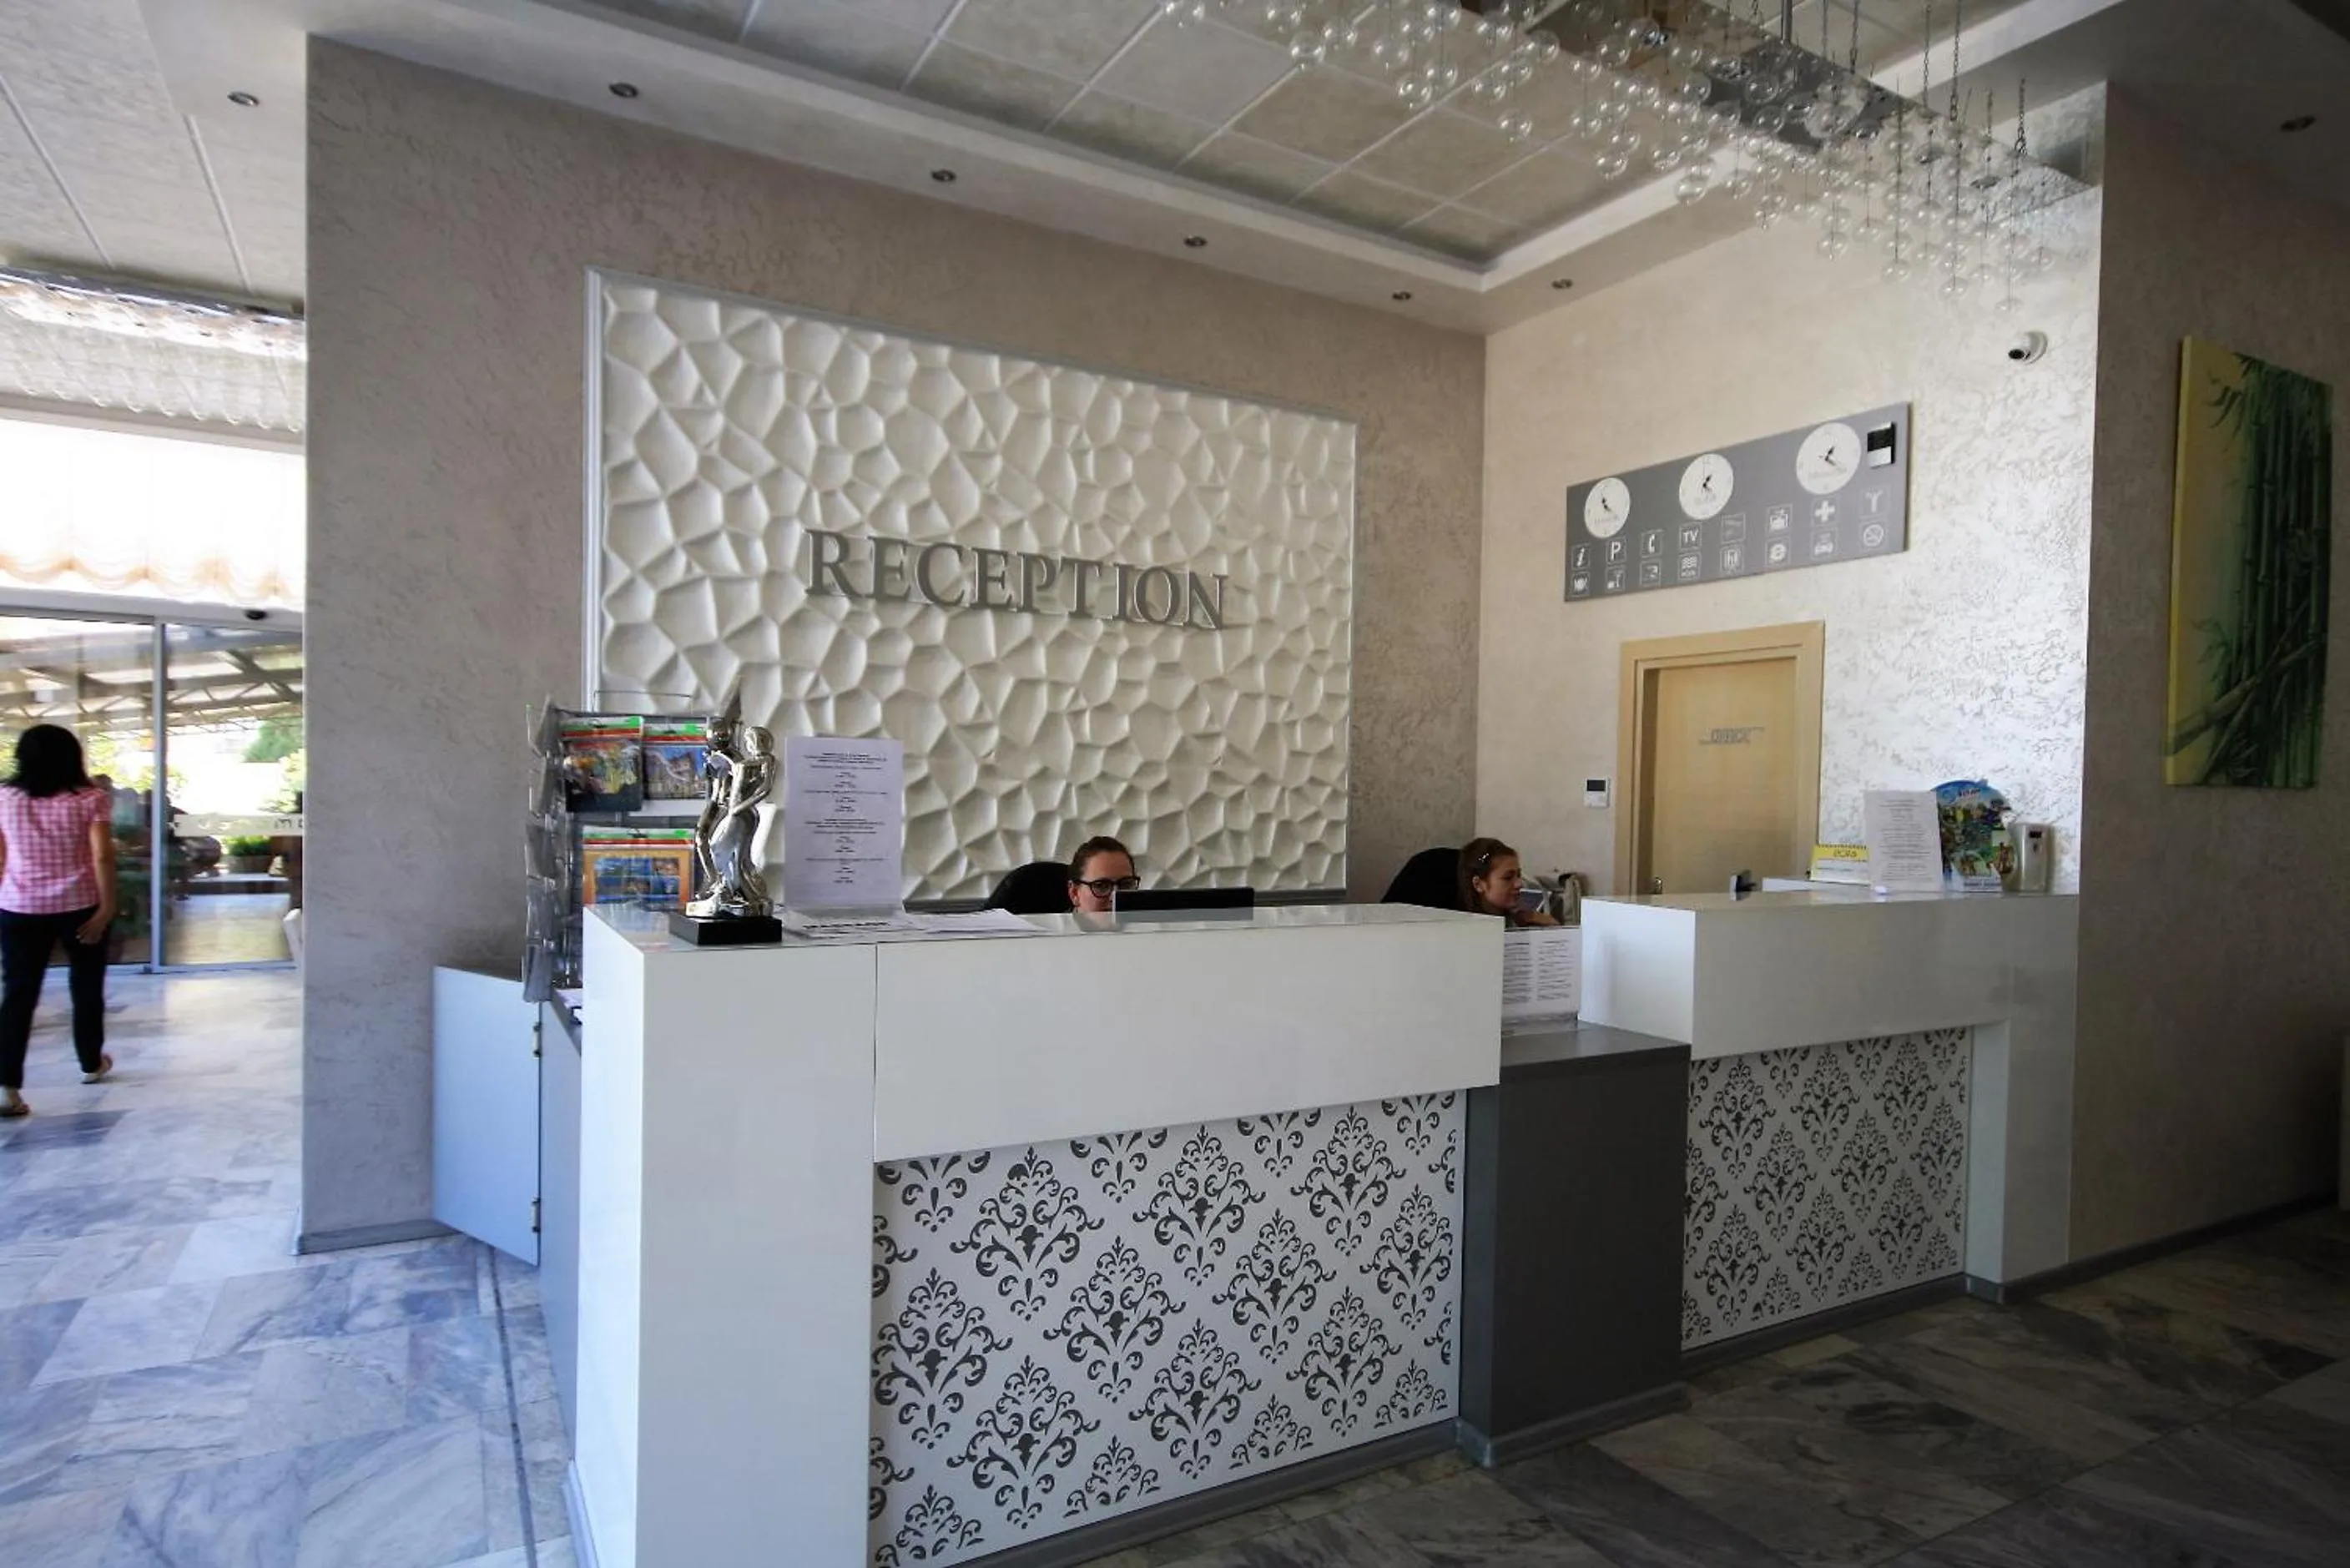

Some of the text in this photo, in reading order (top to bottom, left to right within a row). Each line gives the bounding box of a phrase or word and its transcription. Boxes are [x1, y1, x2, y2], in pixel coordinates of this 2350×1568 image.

[1682, 529, 1699, 543] TV
[1611, 542, 1621, 561] P
[804, 530, 1228, 629] RECEPTION
